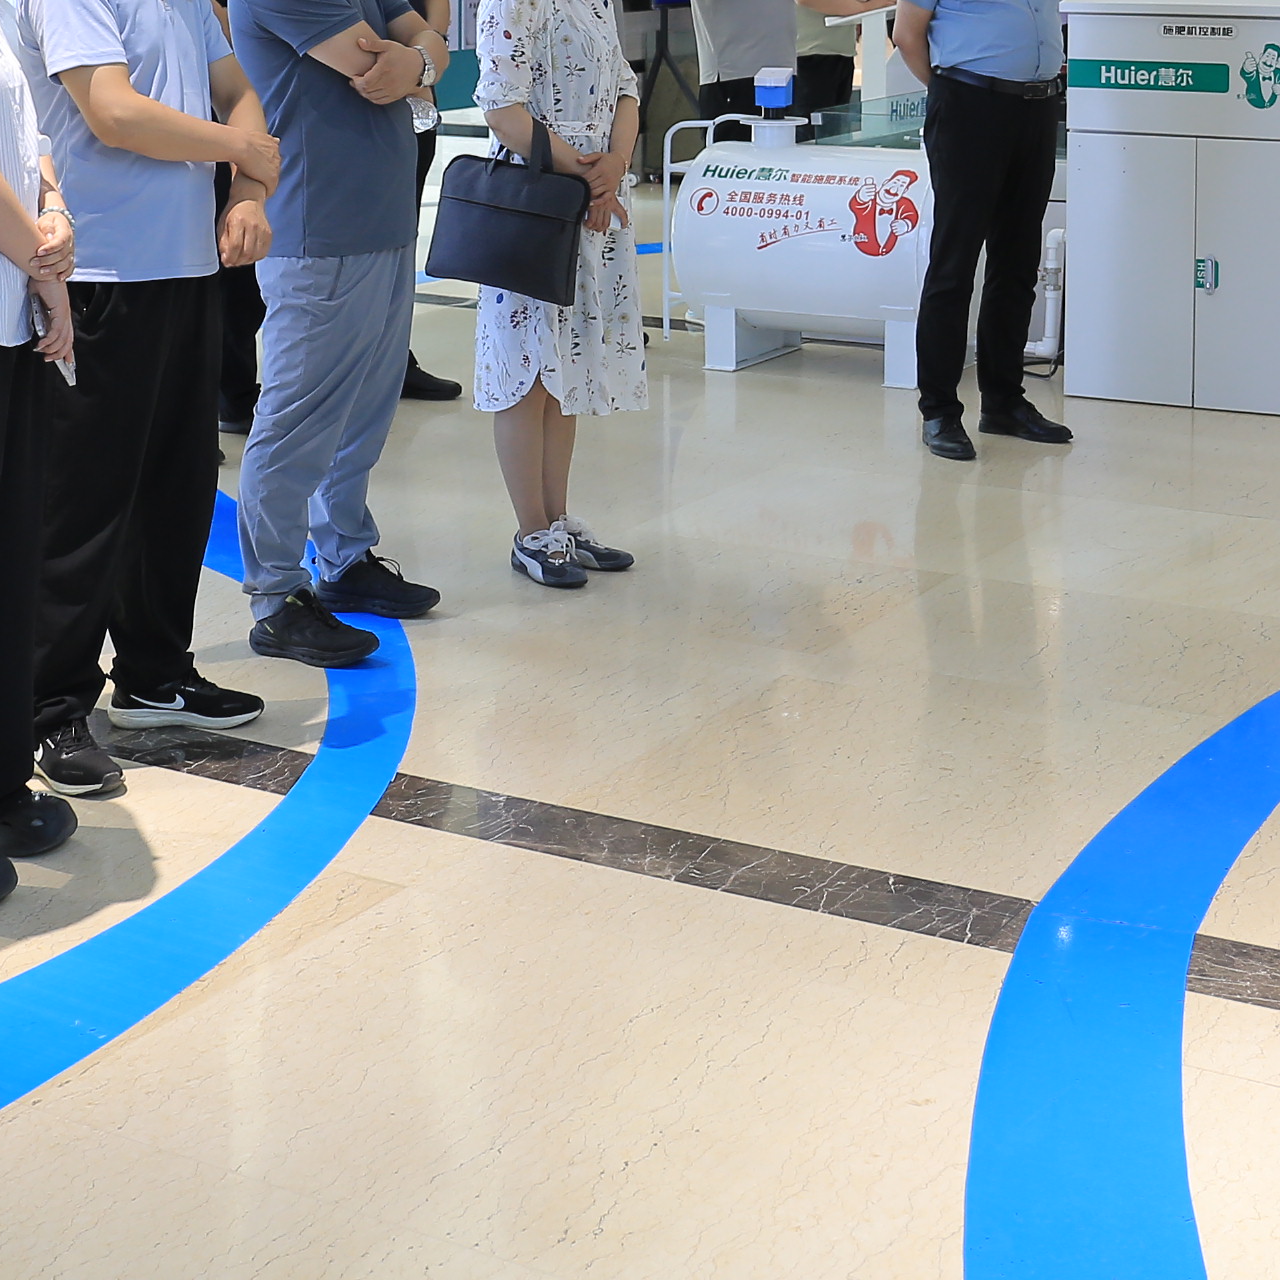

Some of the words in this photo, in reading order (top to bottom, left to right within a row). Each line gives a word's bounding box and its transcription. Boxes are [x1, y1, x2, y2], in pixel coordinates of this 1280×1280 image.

[1163, 25, 1233, 37] 施肥机控制柜
[1100, 65, 1193, 87] Huier慧尔
[701, 163, 790, 182] Huier慧尔
[790, 172, 861, 186] 智能施肥系统
[725, 190, 805, 206] 全国服务热线
[722, 206, 810, 221] 4000-0994-01
[1197, 262, 1205, 285] HSF
